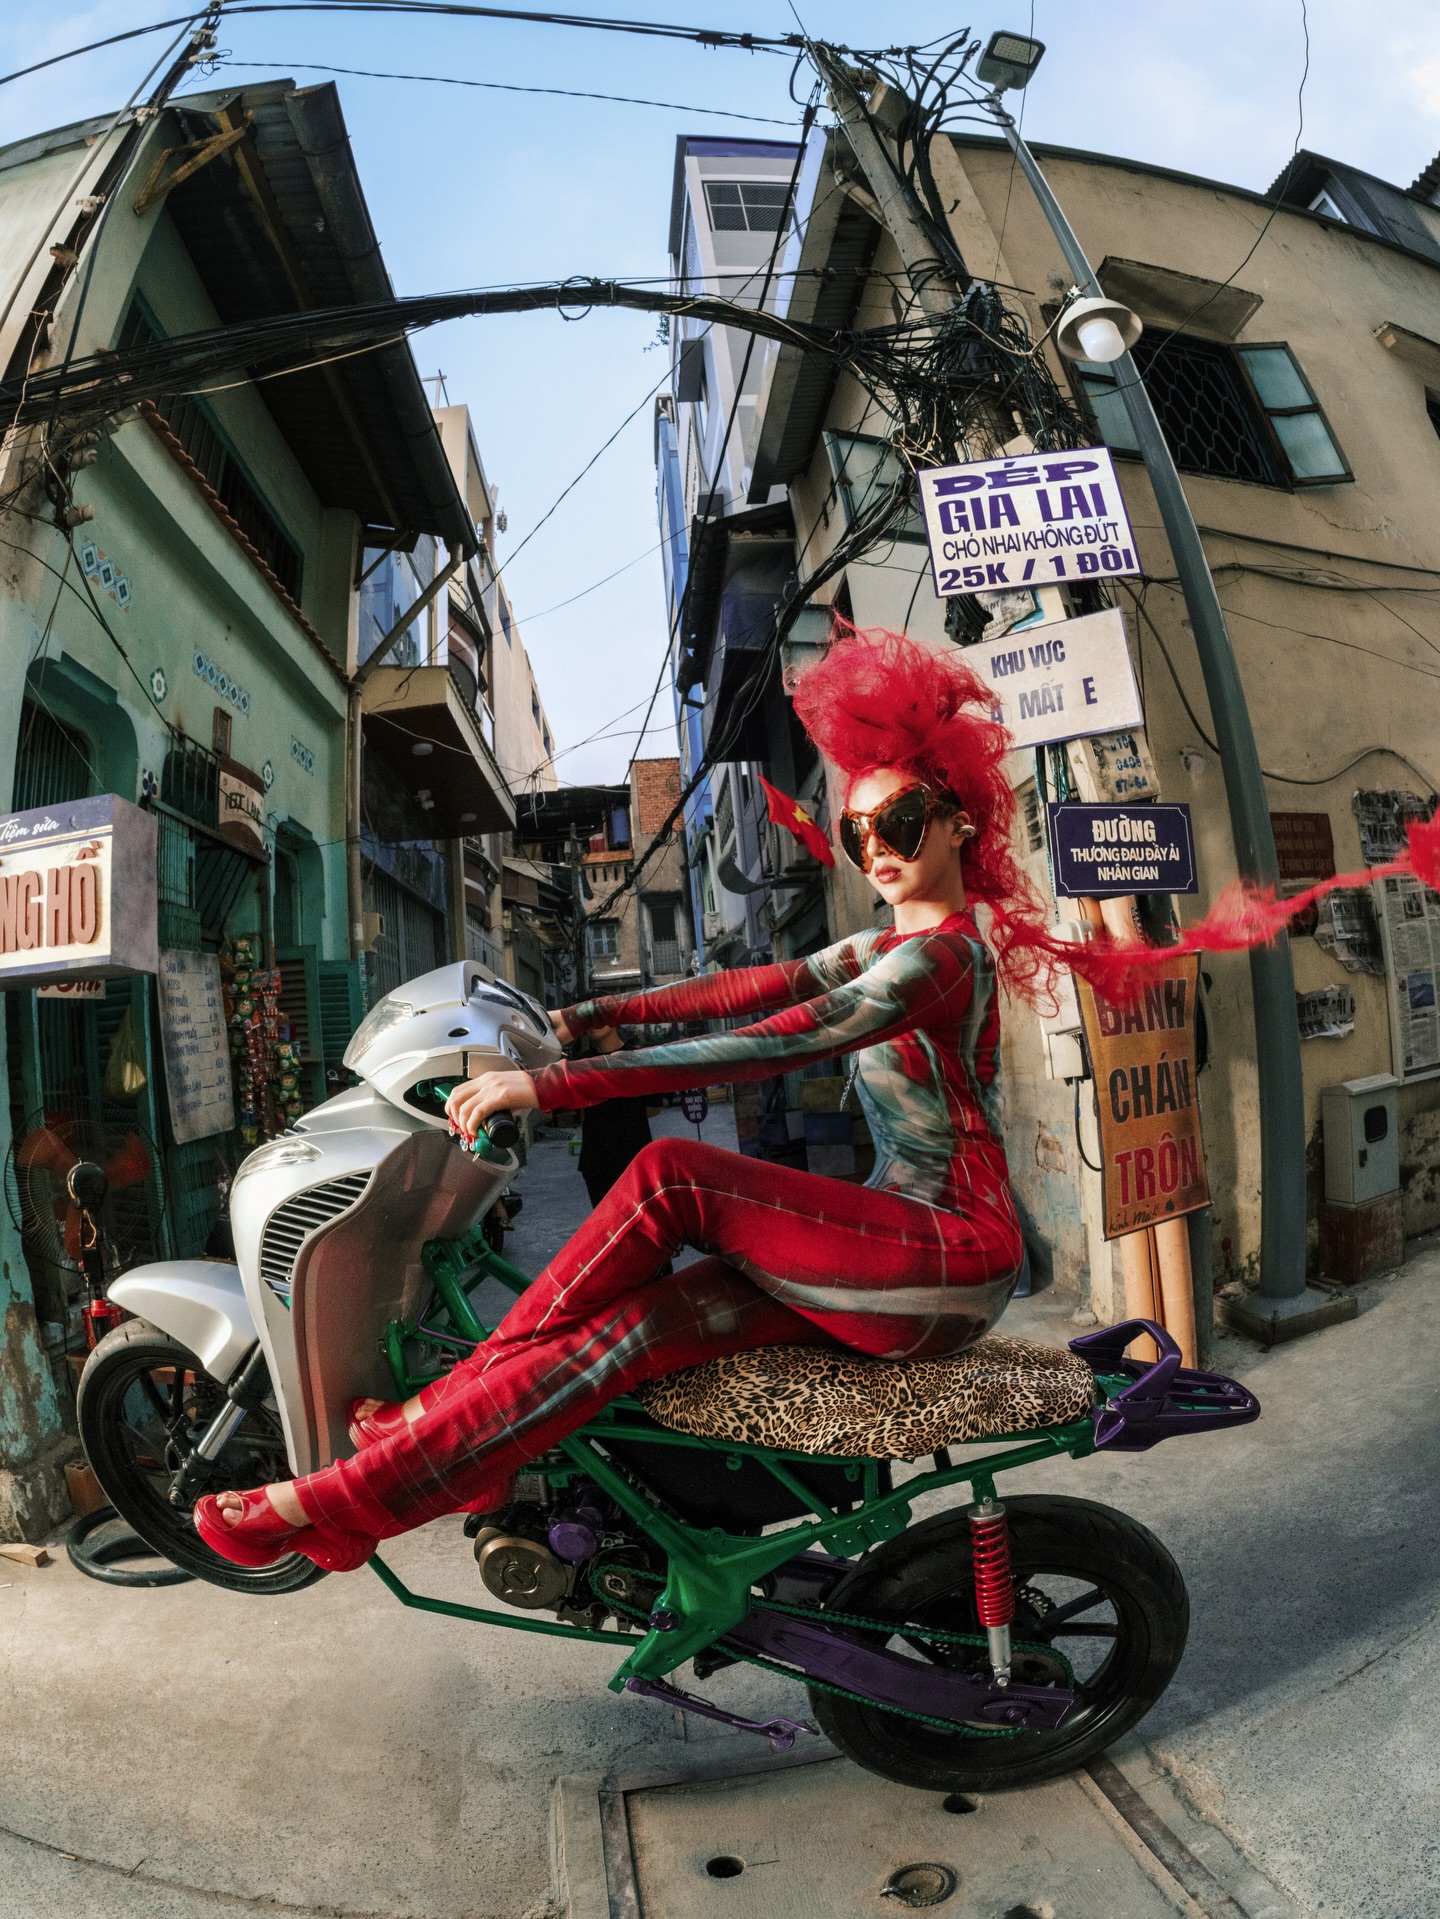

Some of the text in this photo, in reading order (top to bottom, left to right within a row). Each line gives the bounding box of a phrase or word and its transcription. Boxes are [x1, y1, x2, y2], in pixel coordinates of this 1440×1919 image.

[933, 461, 1099, 497] DÉP
[938, 483, 1108, 535] GIA LAI
[943, 533, 982, 561] CHÓ
[984, 532, 1021, 556] NHAI
[1024, 523, 1084, 551] KHÔNG
[939, 561, 1010, 591] 25K
[1049, 555, 1066, 577] 1
[1077, 544, 1135, 574] ĐÔI
[991, 640, 1066, 678] KHU VỰC
[1092, 813, 1156, 843] ĐƯỜNG
[1070, 845, 1120, 862] THƯƠNG
[1121, 847, 1144, 861] ĐAU
[1097, 863, 1159, 881] NHÂN GIAN
[46, 840, 102, 947] HỒ
[1109, 1052, 1192, 1123] CHÁN
[1114, 1131, 1200, 1207] TRÔN
